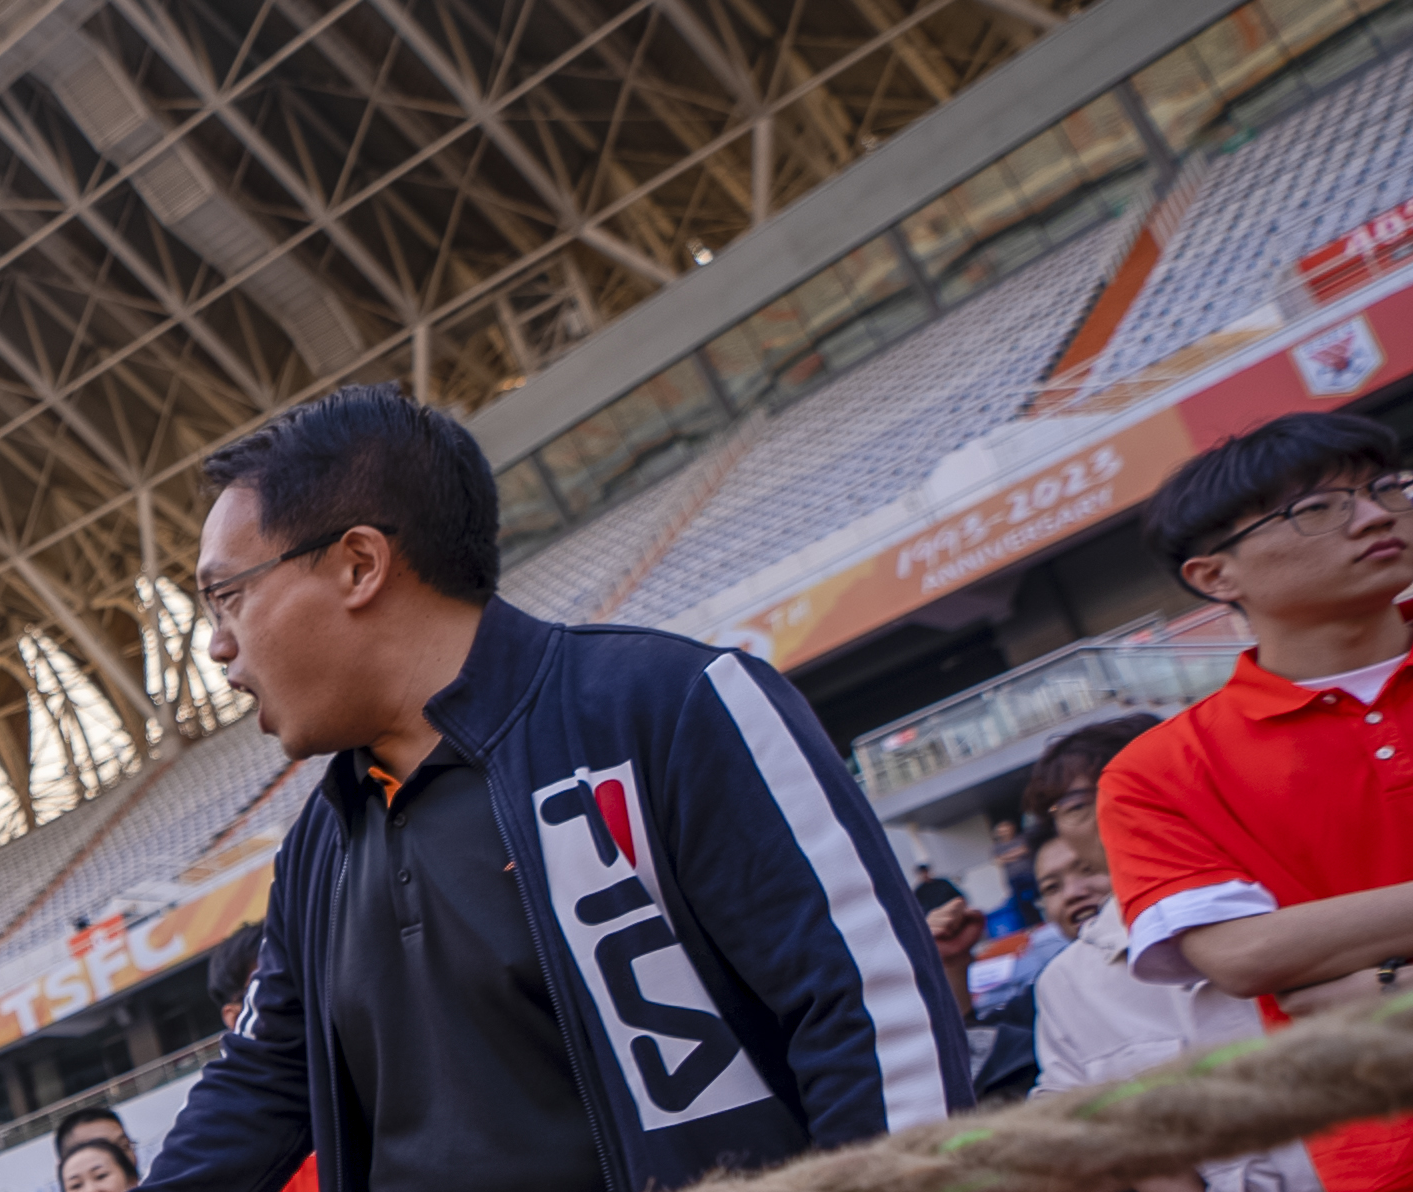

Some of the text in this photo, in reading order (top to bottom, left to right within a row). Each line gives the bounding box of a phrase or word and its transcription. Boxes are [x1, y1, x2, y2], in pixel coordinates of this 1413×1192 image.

[896, 445, 1123, 579] 1993-2023
[922, 485, 1114, 594] ANNIVERSARY
[540, 778, 742, 1114] FILA
